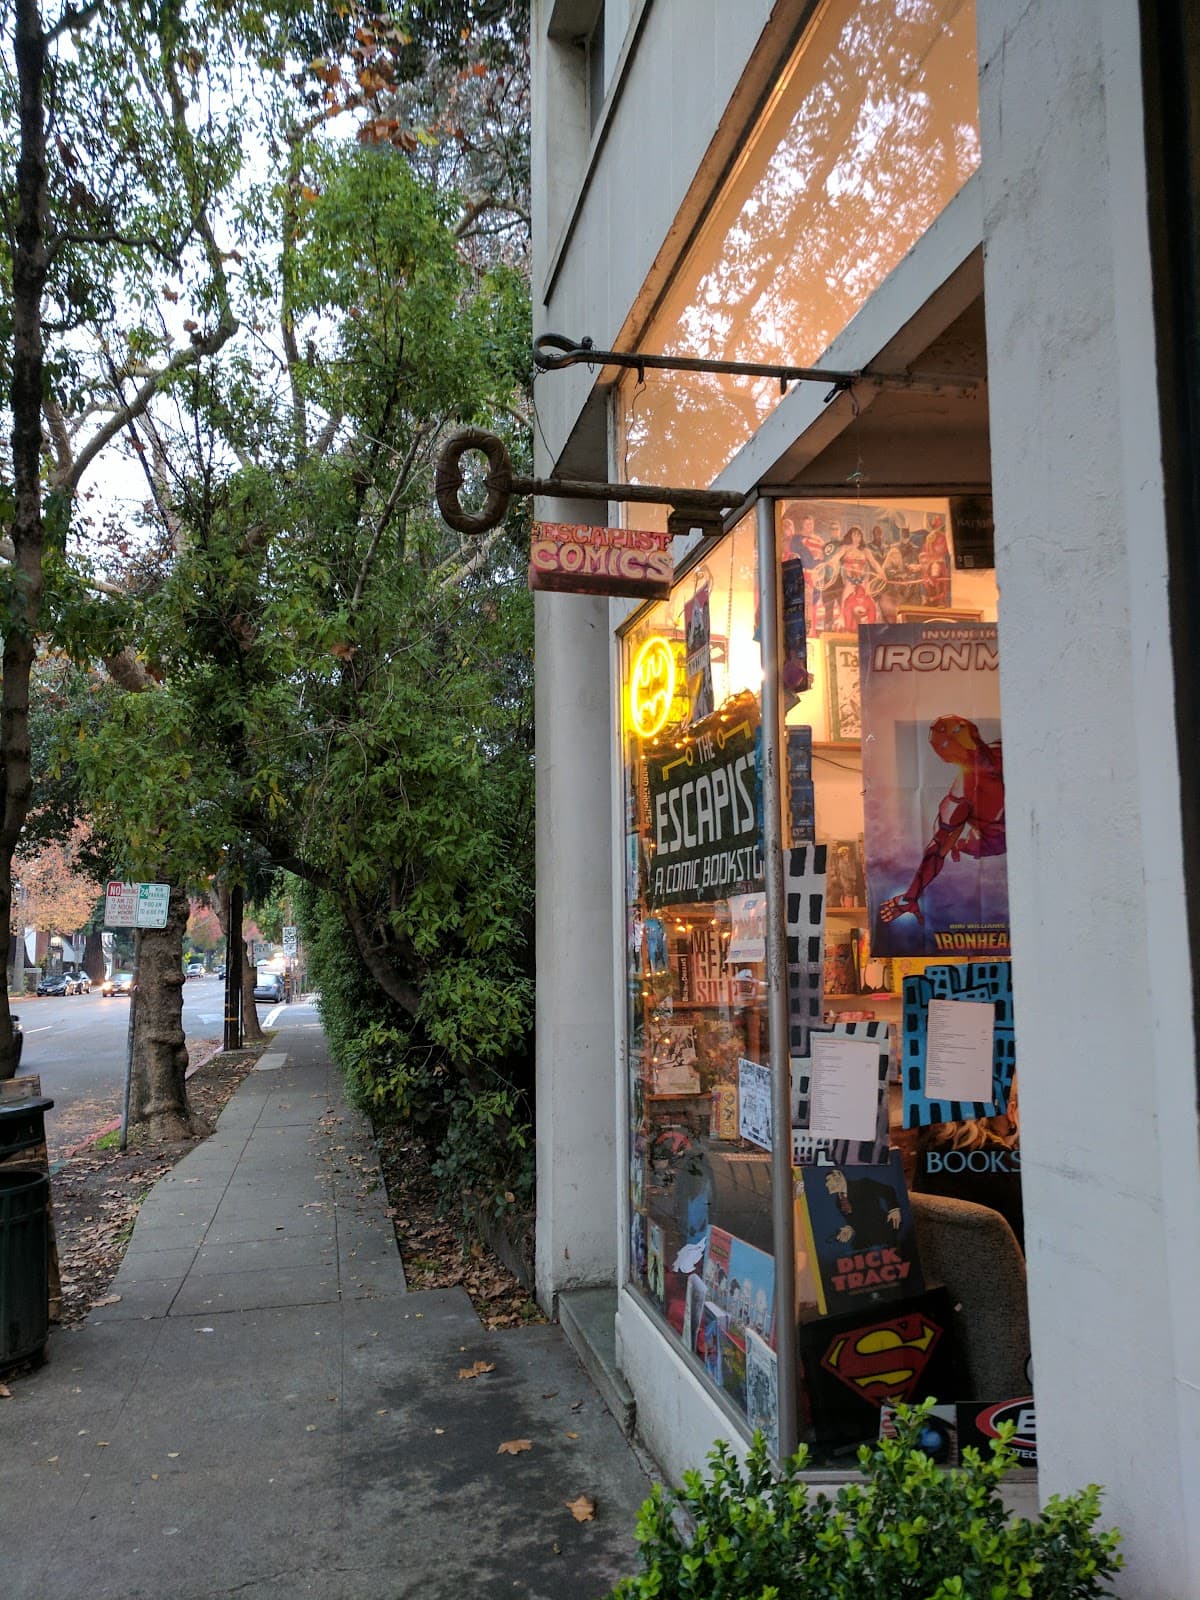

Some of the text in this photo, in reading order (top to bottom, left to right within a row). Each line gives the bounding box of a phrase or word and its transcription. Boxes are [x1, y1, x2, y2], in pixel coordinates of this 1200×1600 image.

[542, 524, 673, 551] ESCAPIST
[532, 541, 674, 581] COMICS
[696, 731, 716, 764] THE
[655, 845, 766, 896] A COMIC BOOKSTO
[110, 885, 121, 896] NO
[934, 931, 1011, 950] IRONHEA
[926, 1150, 1022, 1174] BOOKS
[837, 1248, 901, 1273] DICK
[831, 1262, 911, 1292] TRACY
